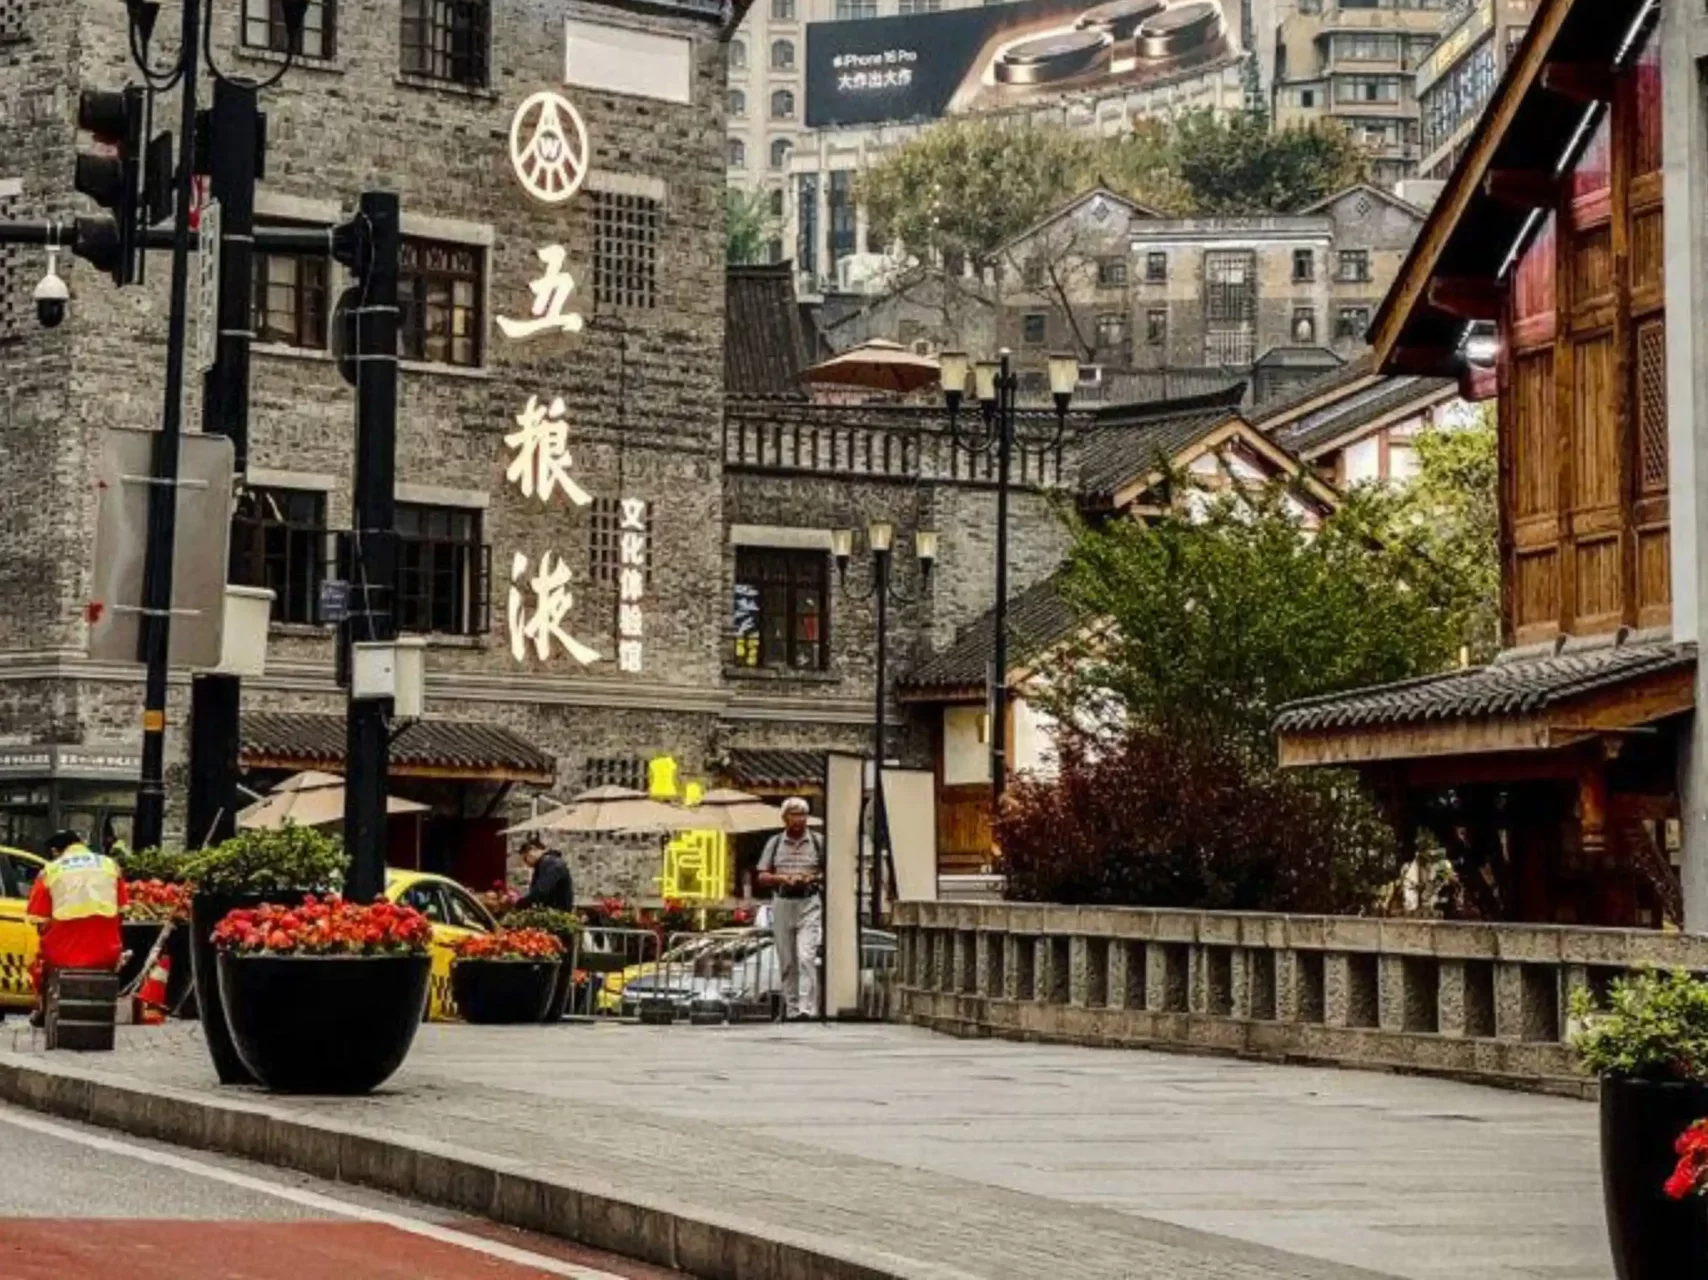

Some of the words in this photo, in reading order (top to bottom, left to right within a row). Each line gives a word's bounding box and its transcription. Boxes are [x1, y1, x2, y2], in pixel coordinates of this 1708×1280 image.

[843, 53, 882, 67] iPhone
[898, 49, 917, 62] Pro
[837, 68, 913, 91] 大作出大作
[497, 244, 602, 665] 五粮液
